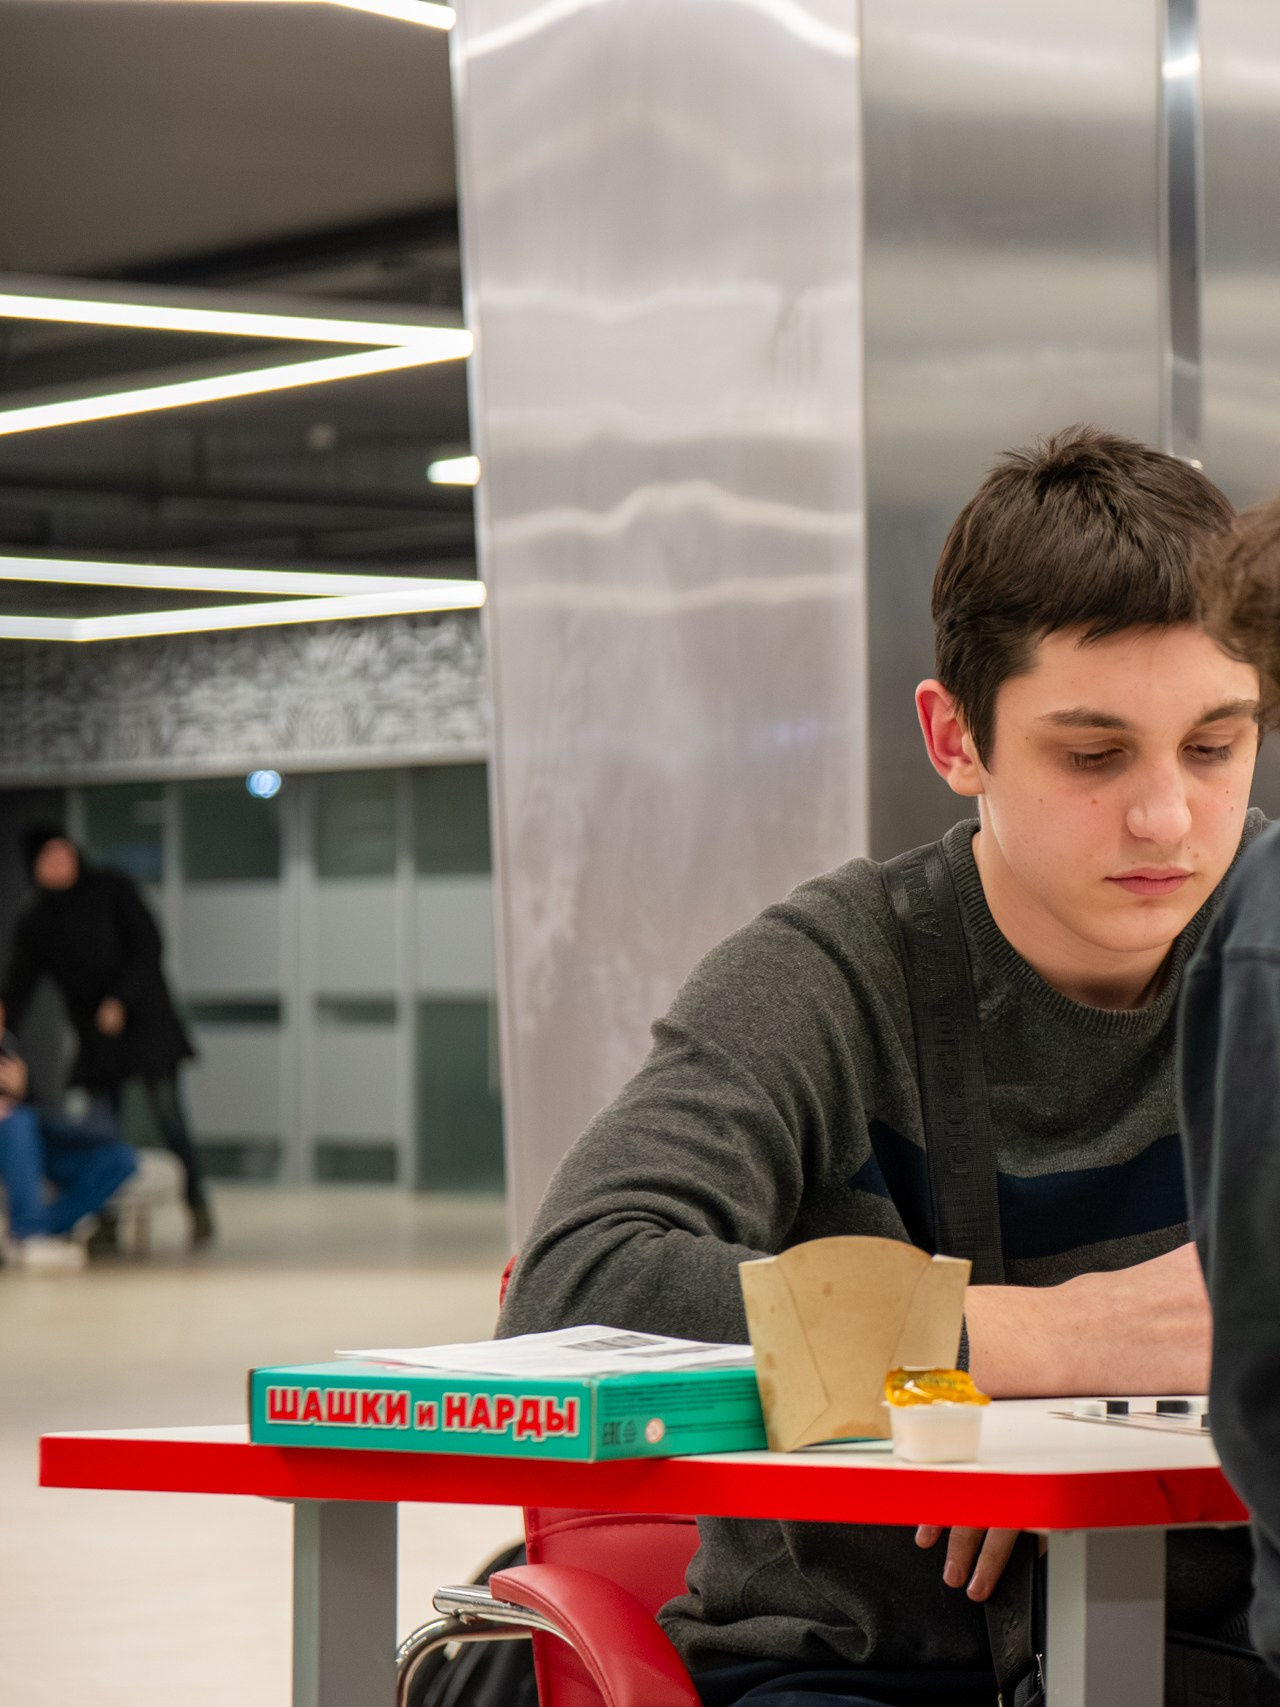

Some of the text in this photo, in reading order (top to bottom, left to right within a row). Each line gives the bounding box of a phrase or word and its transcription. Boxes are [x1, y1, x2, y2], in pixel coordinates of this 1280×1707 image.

[267, 1387, 410, 1429] ШАШКИ
[415, 1402, 437, 1430] и
[443, 1393, 579, 1440] НАРДЫ
